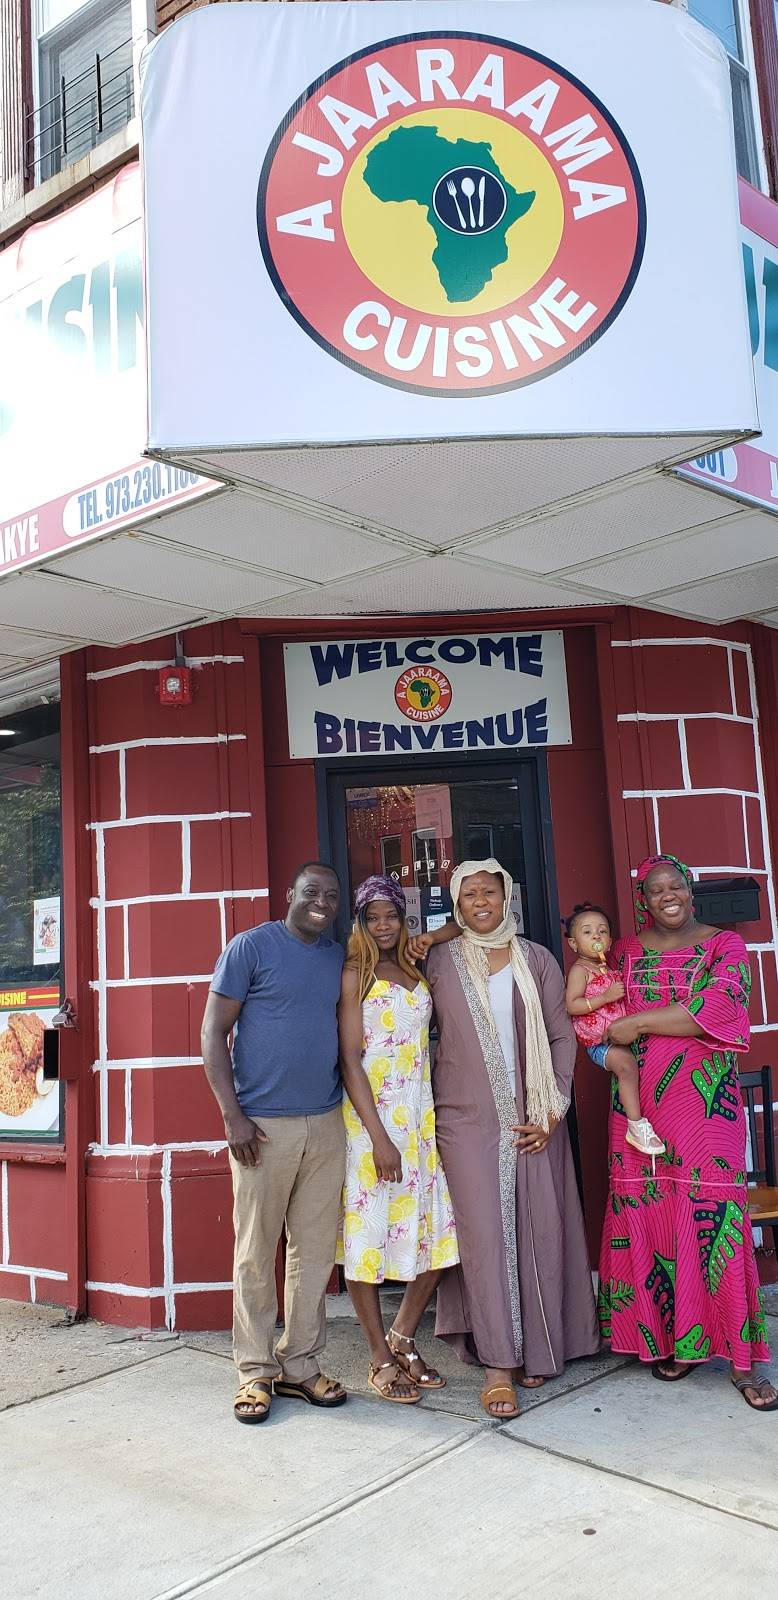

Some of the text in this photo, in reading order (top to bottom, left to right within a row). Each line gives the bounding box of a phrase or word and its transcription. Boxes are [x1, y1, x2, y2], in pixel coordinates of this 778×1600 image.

[276, 48, 628, 242] A JAARAAMA
[342, 277, 598, 378] CUISINE
[78, 489, 103, 530] TEL.
[0, 514, 40, 565] KYE
[310, 634, 543, 687] WELCOME
[400, 667, 450, 696] JAARAAMA
[313, 697, 548, 755] BIENVENUE
[406, 704, 445, 720] CUISINE
[0, 991, 26, 1006] ISINE
